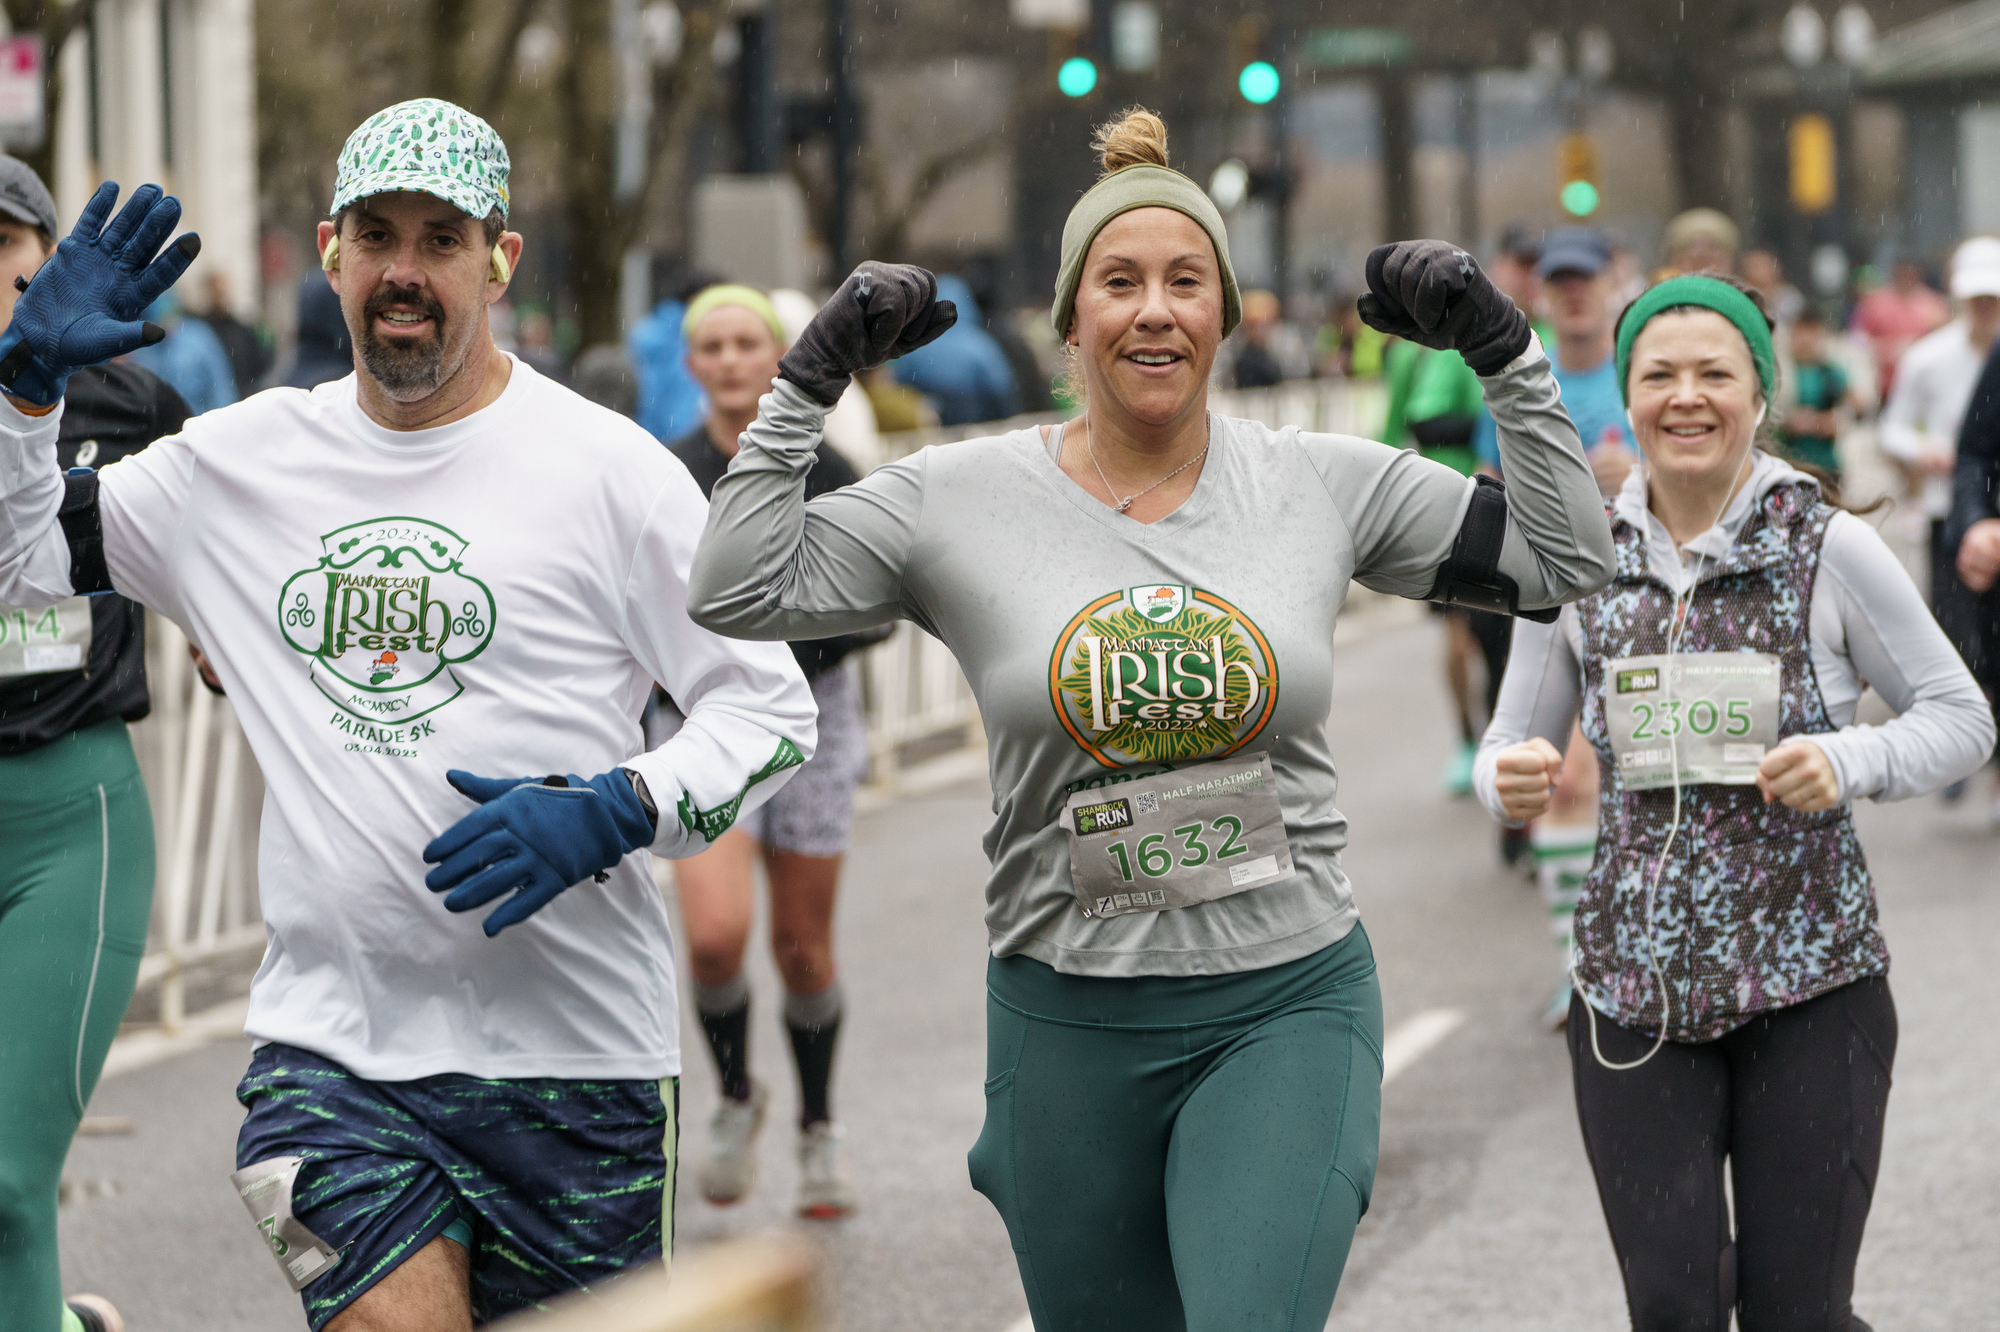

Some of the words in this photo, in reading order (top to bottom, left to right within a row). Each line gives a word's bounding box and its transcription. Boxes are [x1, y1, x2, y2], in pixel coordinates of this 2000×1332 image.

[376, 528, 420, 542] 2023
[1685, 666, 1711, 675] HALF
[1714, 666, 1771, 676] MARATHON
[1632, 674, 1657, 690] RUN
[347, 694, 412, 714] MCMXCV
[330, 712, 405, 743] PARADE
[409, 719, 437, 742] 5K
[1146, 720, 1195, 731] 2022
[1631, 698, 1752, 741] 2305
[344, 742, 418, 758] 03.04.2023
[1162, 785, 1194, 801] HALF
[1196, 768, 1262, 793] MARATHON
[1198, 788, 1229, 800] MARCH
[1244, 779, 1264, 790] 2023
[1077, 800, 1125, 817] SHAMROCK
[1095, 808, 1128, 827] RUN
[1098, 821, 1130, 831] PORTLAND
[1105, 814, 1249, 882] 1632
[257, 1212, 290, 1258] 3
